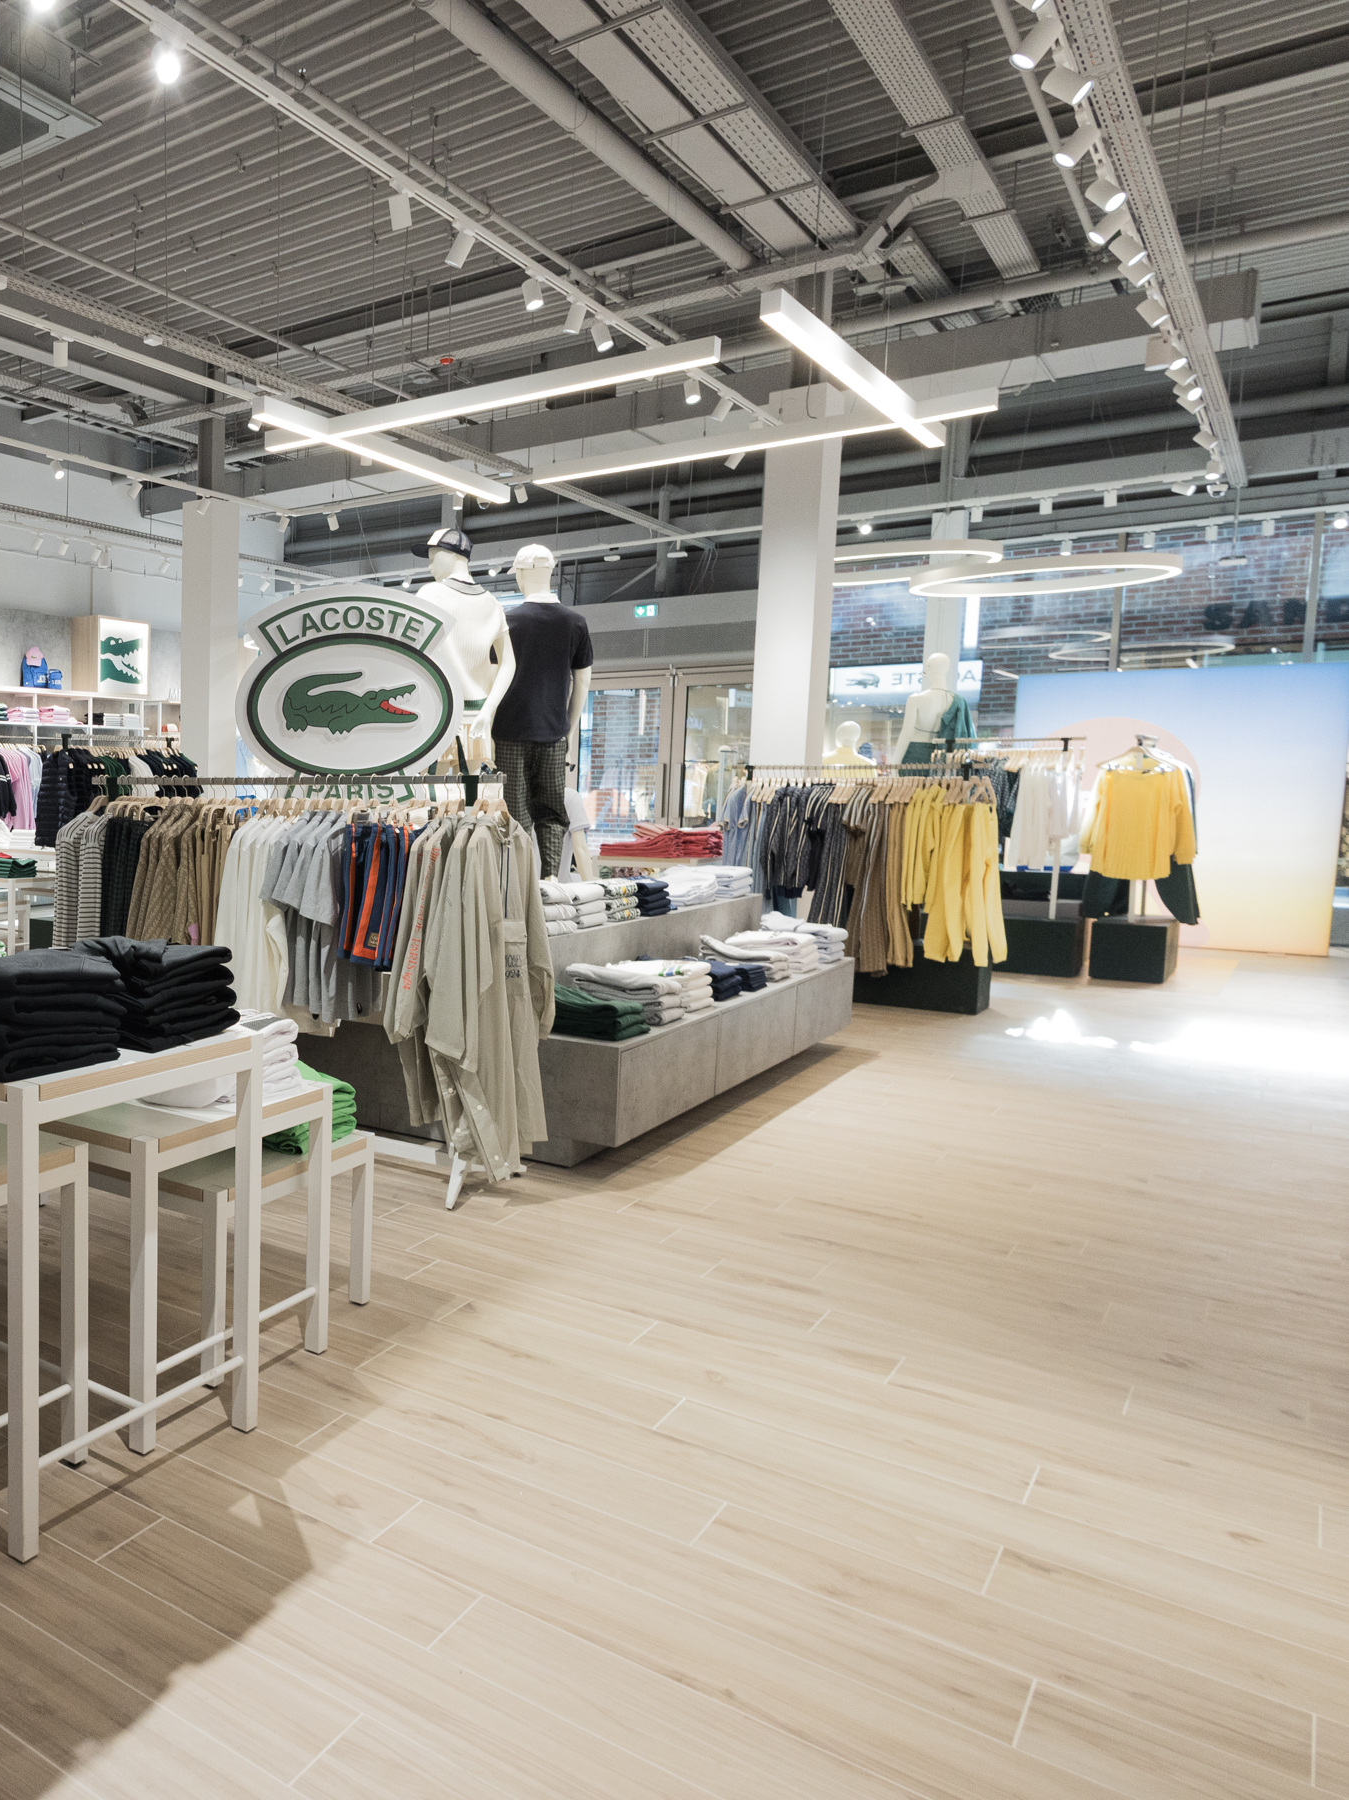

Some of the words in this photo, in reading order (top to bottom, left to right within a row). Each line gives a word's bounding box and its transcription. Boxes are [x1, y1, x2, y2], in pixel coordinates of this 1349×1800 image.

[276, 605, 425, 646] LACOSTE
[406, 939, 421, 970] PARIS
[401, 970, 413, 991] 1924
[505, 969, 520, 980] 924
